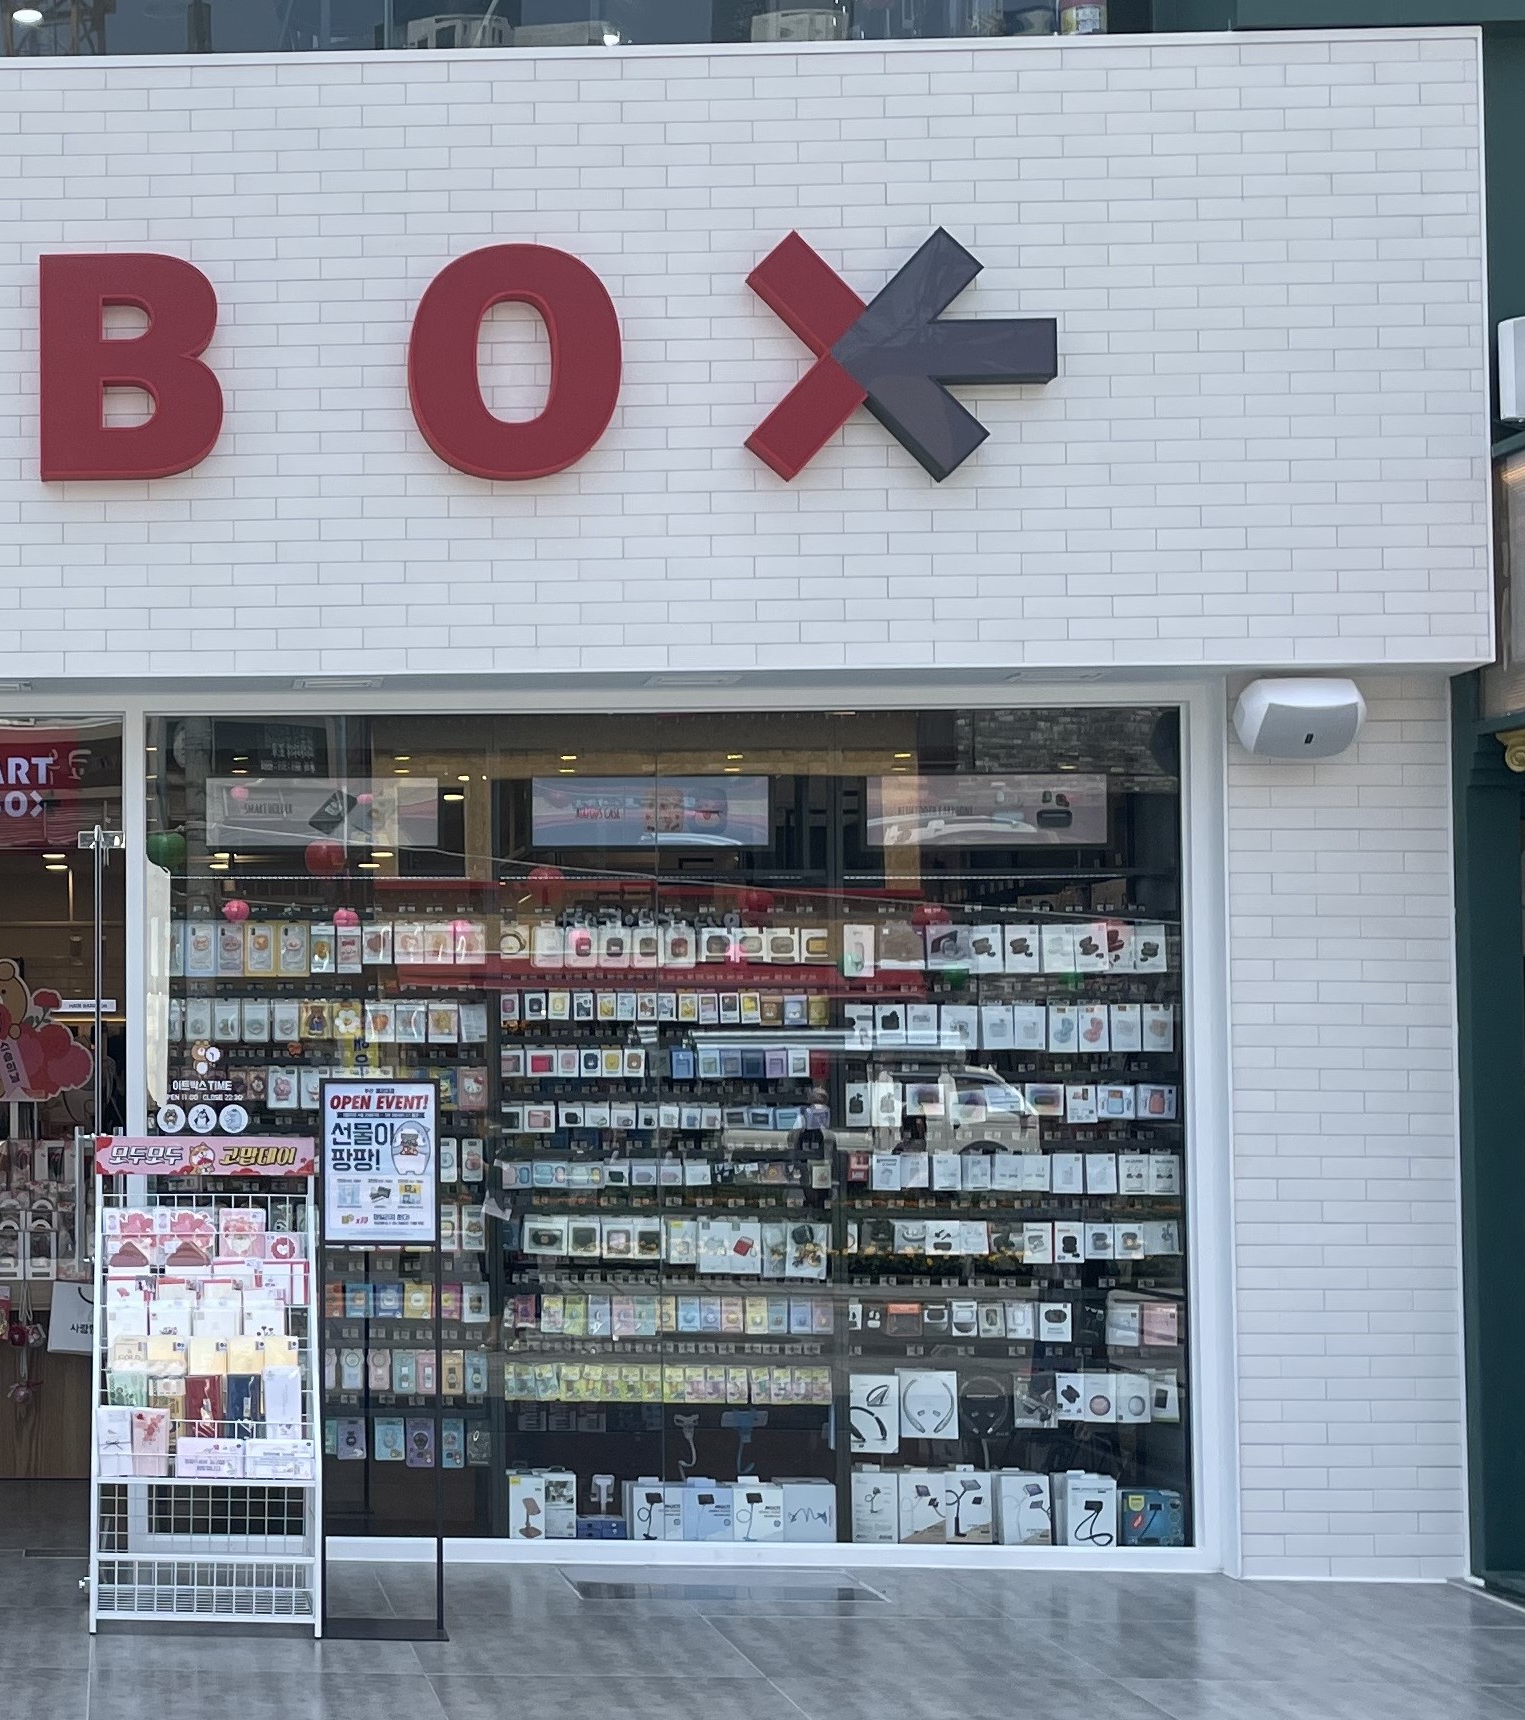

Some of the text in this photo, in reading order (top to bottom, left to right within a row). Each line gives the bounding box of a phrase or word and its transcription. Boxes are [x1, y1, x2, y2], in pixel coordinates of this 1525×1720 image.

[329, 1094, 429, 1111] OPEN EVENT!
[330, 1121, 394, 1147] 선물이
[109, 1144, 184, 1165] 모두모두
[330, 1147, 381, 1172] 팡팡!
